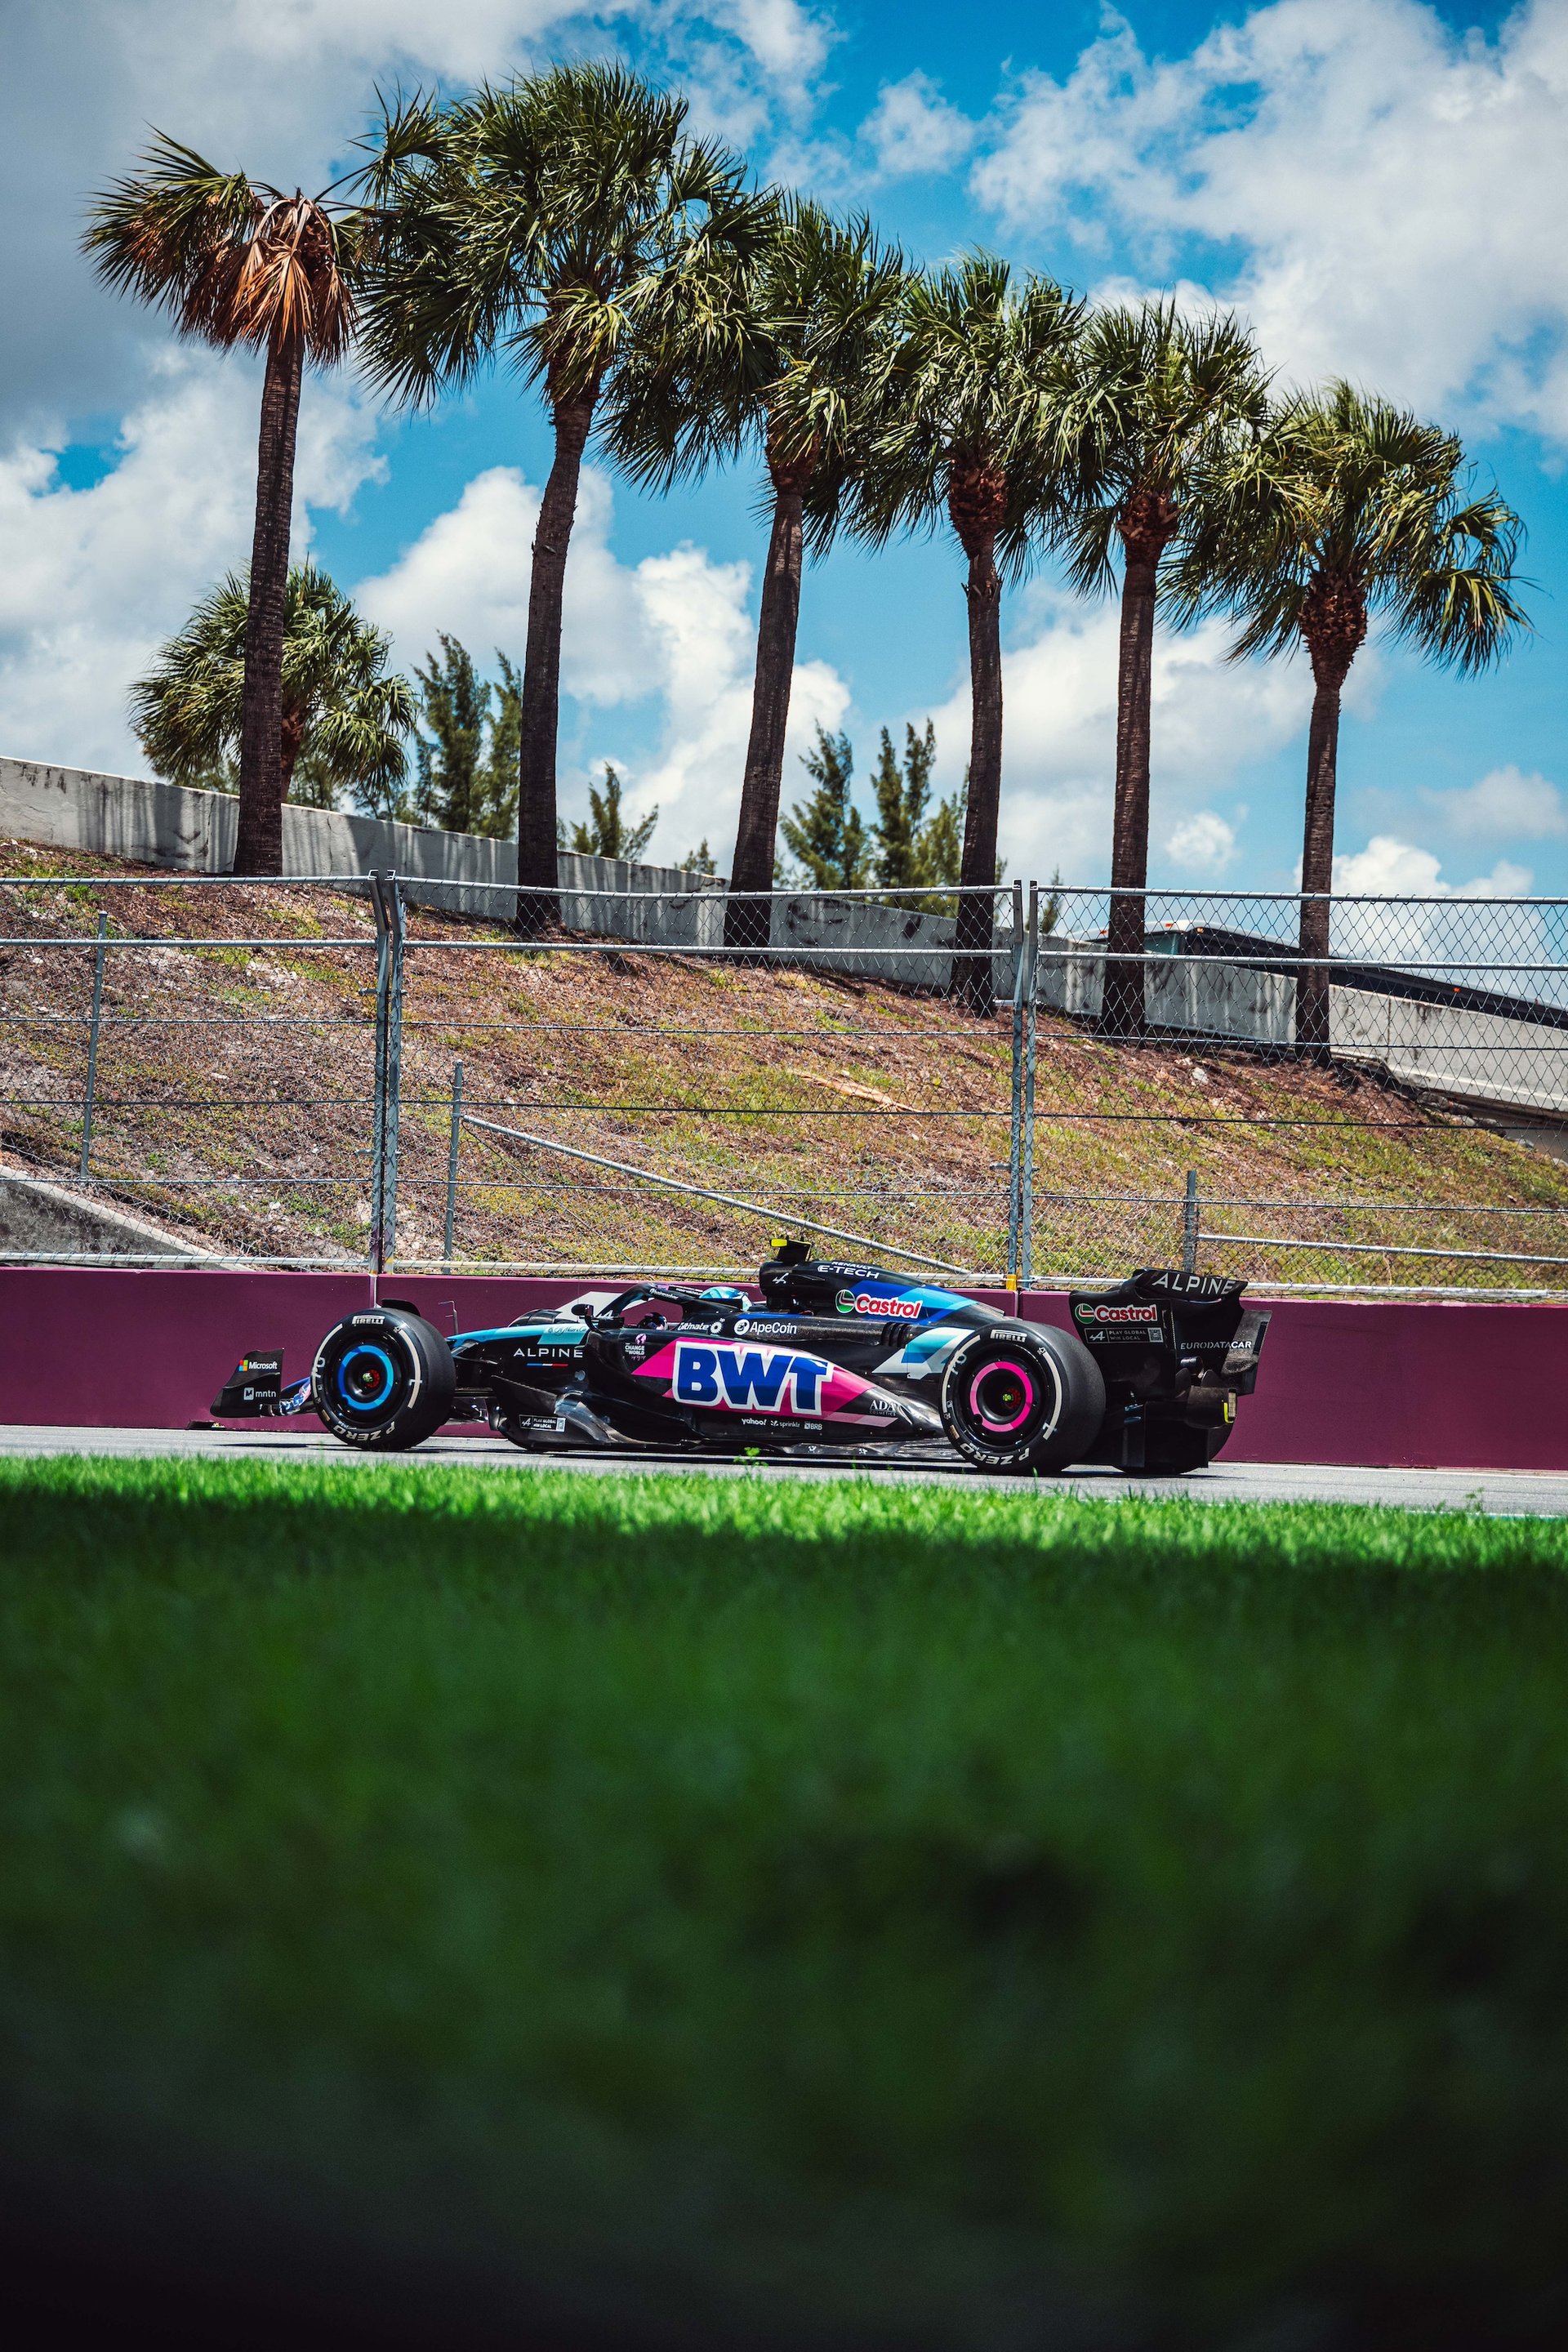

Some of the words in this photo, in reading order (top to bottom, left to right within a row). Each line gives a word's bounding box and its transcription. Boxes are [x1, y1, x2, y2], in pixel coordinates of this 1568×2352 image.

[819, 1265, 880, 1279] E-TECH
[831, 1261, 874, 1270] RENAULT
[1152, 1272, 1236, 1295] ALPINE
[856, 1294, 921, 1317] Castrol
[352, 1315, 385, 1325] PIRELLI
[1096, 1305, 1156, 1321] Castrol
[750, 1321, 797, 1335] ApeCoin
[990, 1329, 1027, 1343] PIRELLI
[1180, 1341, 1252, 1350] EURODATACAR
[513, 1348, 583, 1358] ALPINE
[249, 1361, 278, 1370] Microsoft
[675, 1343, 831, 1413] BWT
[870, 1400, 895, 1411] ADA
[386, 1421, 395, 1435] P
[742, 1418, 767, 1426] yahoo!
[333, 1424, 381, 1441] ZERO
[960, 1443, 1013, 1465] ZERO
[1018, 1447, 1030, 1461] P
